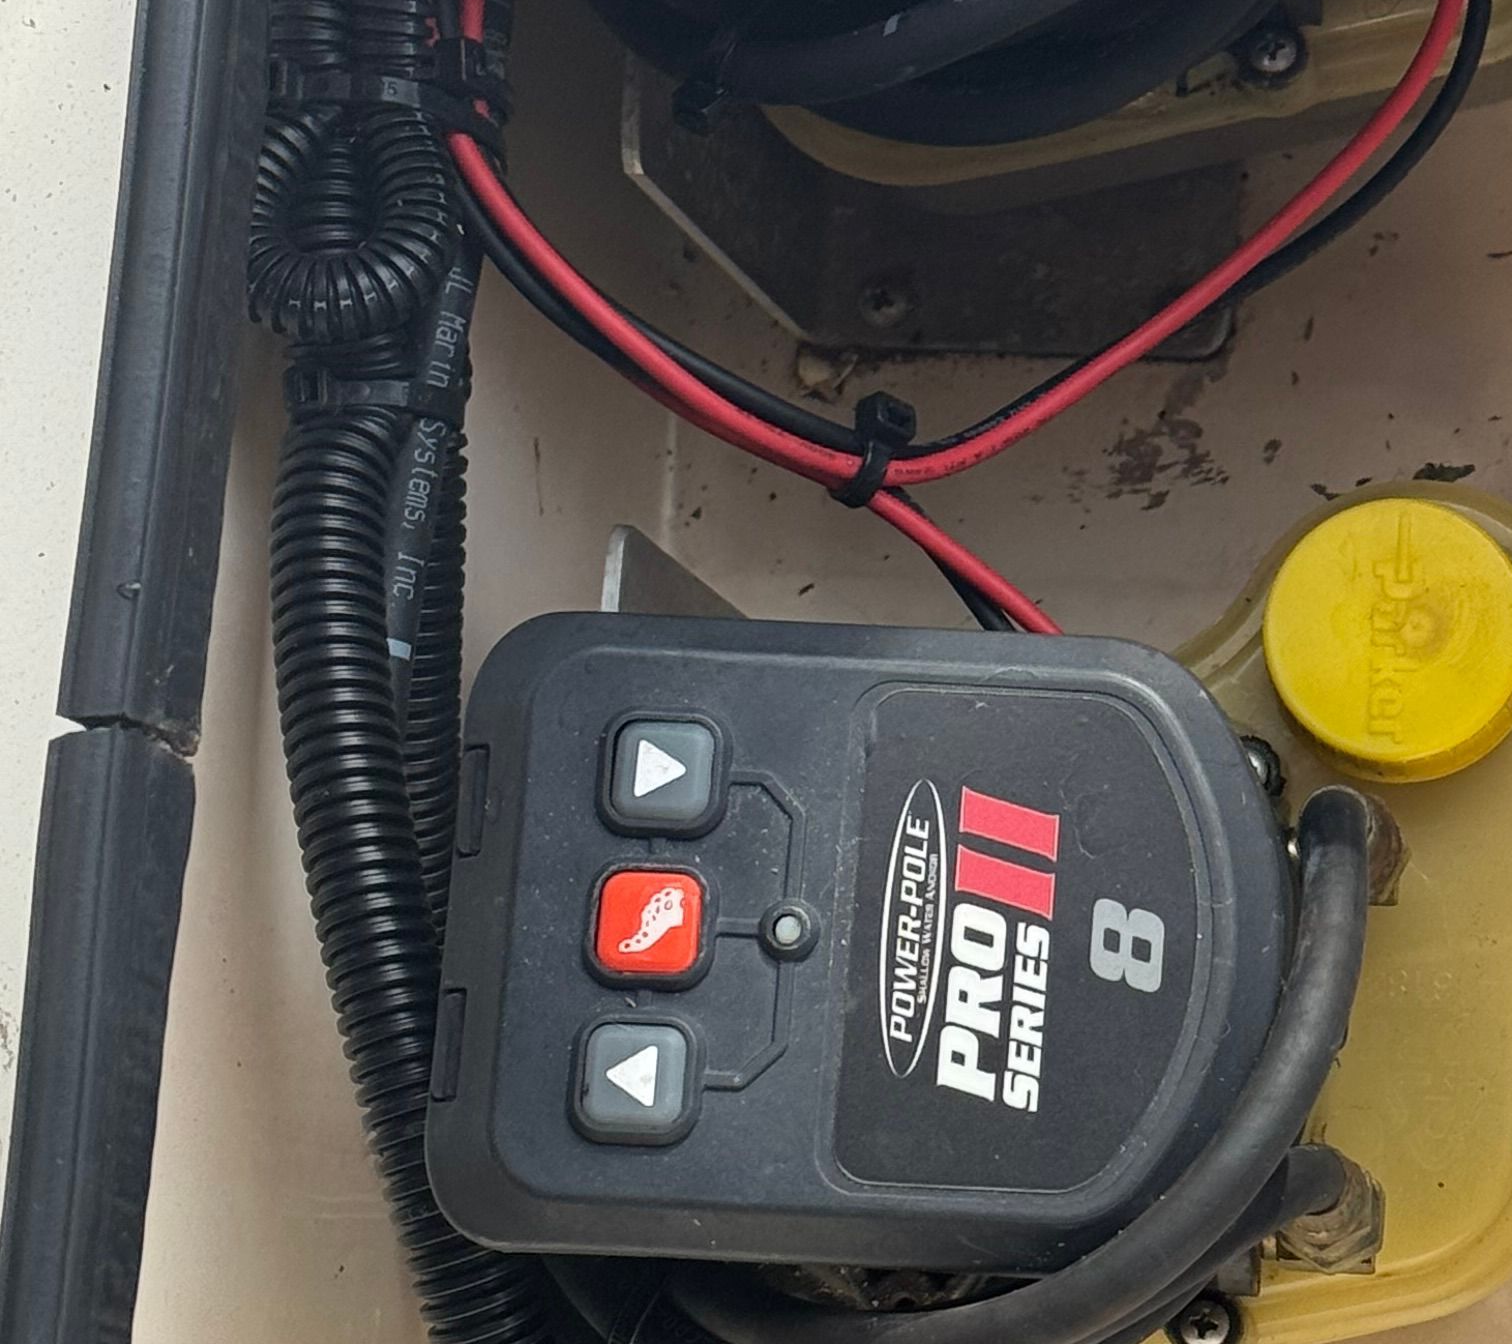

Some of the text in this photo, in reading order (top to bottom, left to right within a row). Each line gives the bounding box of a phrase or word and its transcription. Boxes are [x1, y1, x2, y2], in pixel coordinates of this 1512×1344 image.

[443, 266, 473, 297] JL
[427, 311, 468, 390] Marin
[401, 417, 448, 530] Systems,
[889, 815, 930, 1042] POWER-POLE
[1089, 898, 1165, 992] 8
[936, 903, 1007, 1101] PRO
[1002, 922, 1050, 1112] SERIES
